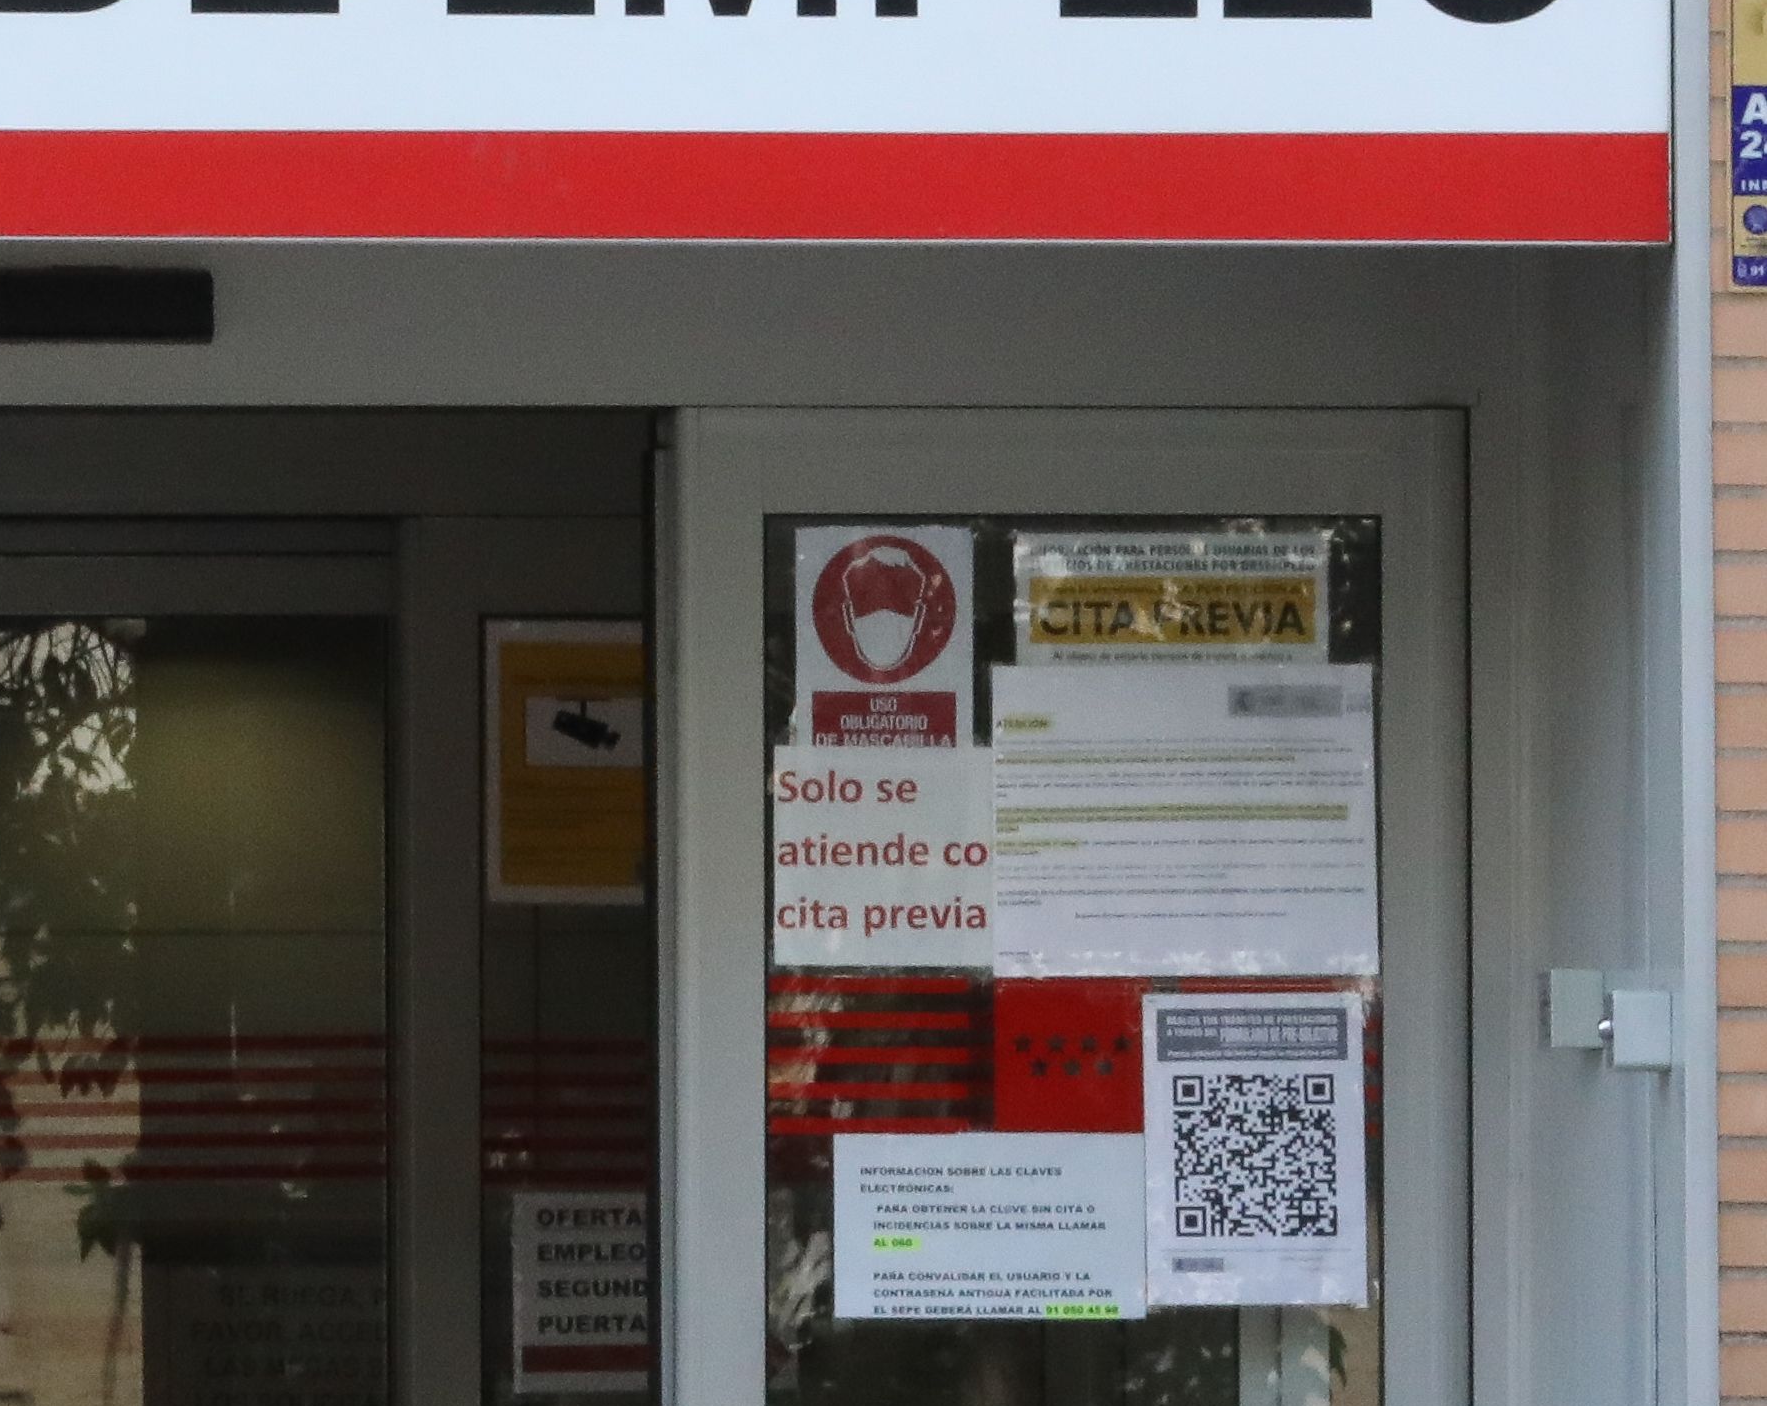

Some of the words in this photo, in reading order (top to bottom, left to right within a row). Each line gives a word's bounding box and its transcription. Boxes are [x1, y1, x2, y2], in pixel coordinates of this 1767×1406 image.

[1739, 129, 1767, 160] 2
[1039, 599, 1134, 636] CITA
[869, 696, 898, 713] USO
[839, 714, 929, 731] OBLIGATORIO
[777, 769, 863, 803] Solo
[875, 778, 919, 803] se
[777, 832, 930, 867] atiende
[942, 841, 989, 867] co
[777, 895, 849, 930] cita
[863, 895, 987, 937] previa
[537, 1207, 642, 1228] OFERTA
[970, 1204, 986, 1214] LA
[1054, 1204, 1084, 1214] CITA
[537, 1242, 647, 1262] EMPLEO
[538, 1314, 647, 1334] PUERTA
